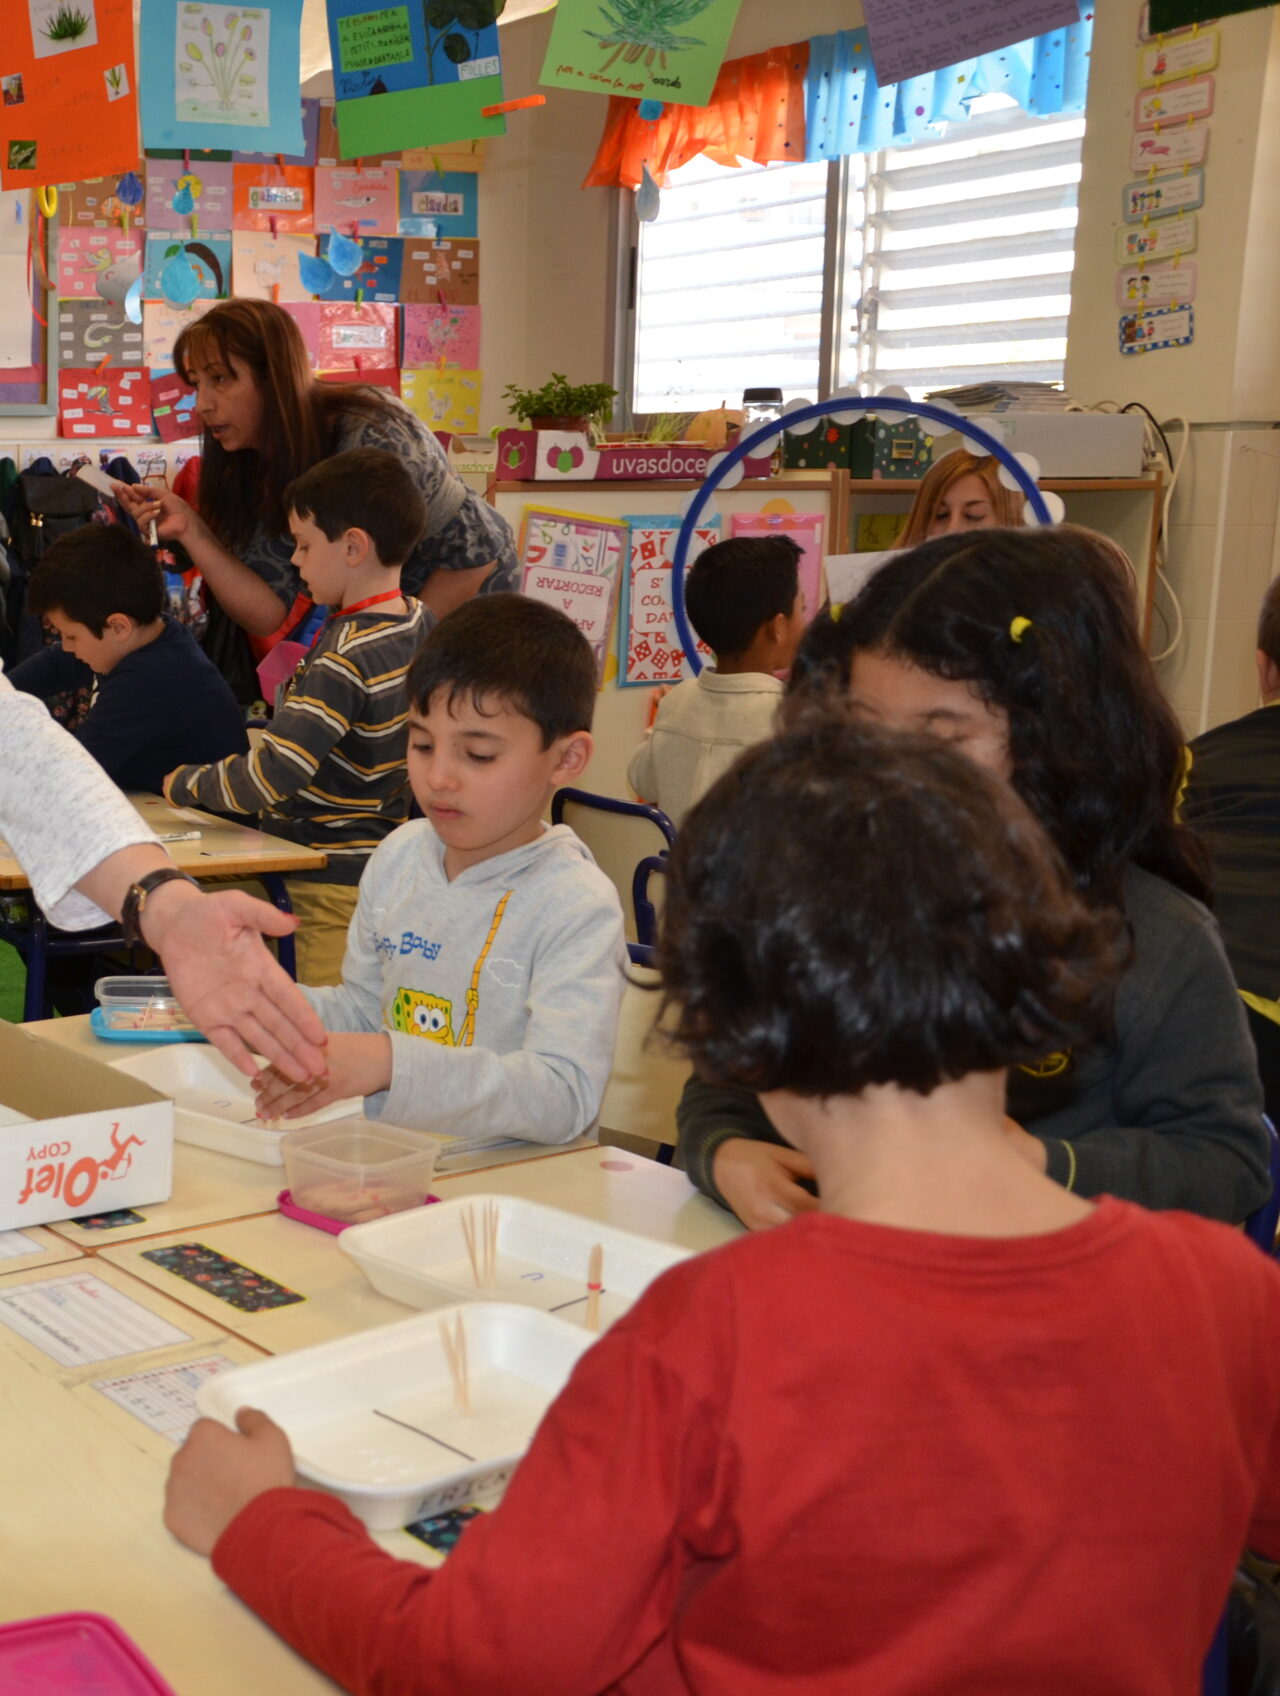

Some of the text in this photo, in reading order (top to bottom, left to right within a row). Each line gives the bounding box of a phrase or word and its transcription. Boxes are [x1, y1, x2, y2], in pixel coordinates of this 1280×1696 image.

[612, 450, 707, 475] uvasdoce
[535, 576, 604, 598] RECORTAR
[562, 598, 574, 610] A
[399, 931, 442, 961] Baby
[26, 1140, 72, 1162] COPY
